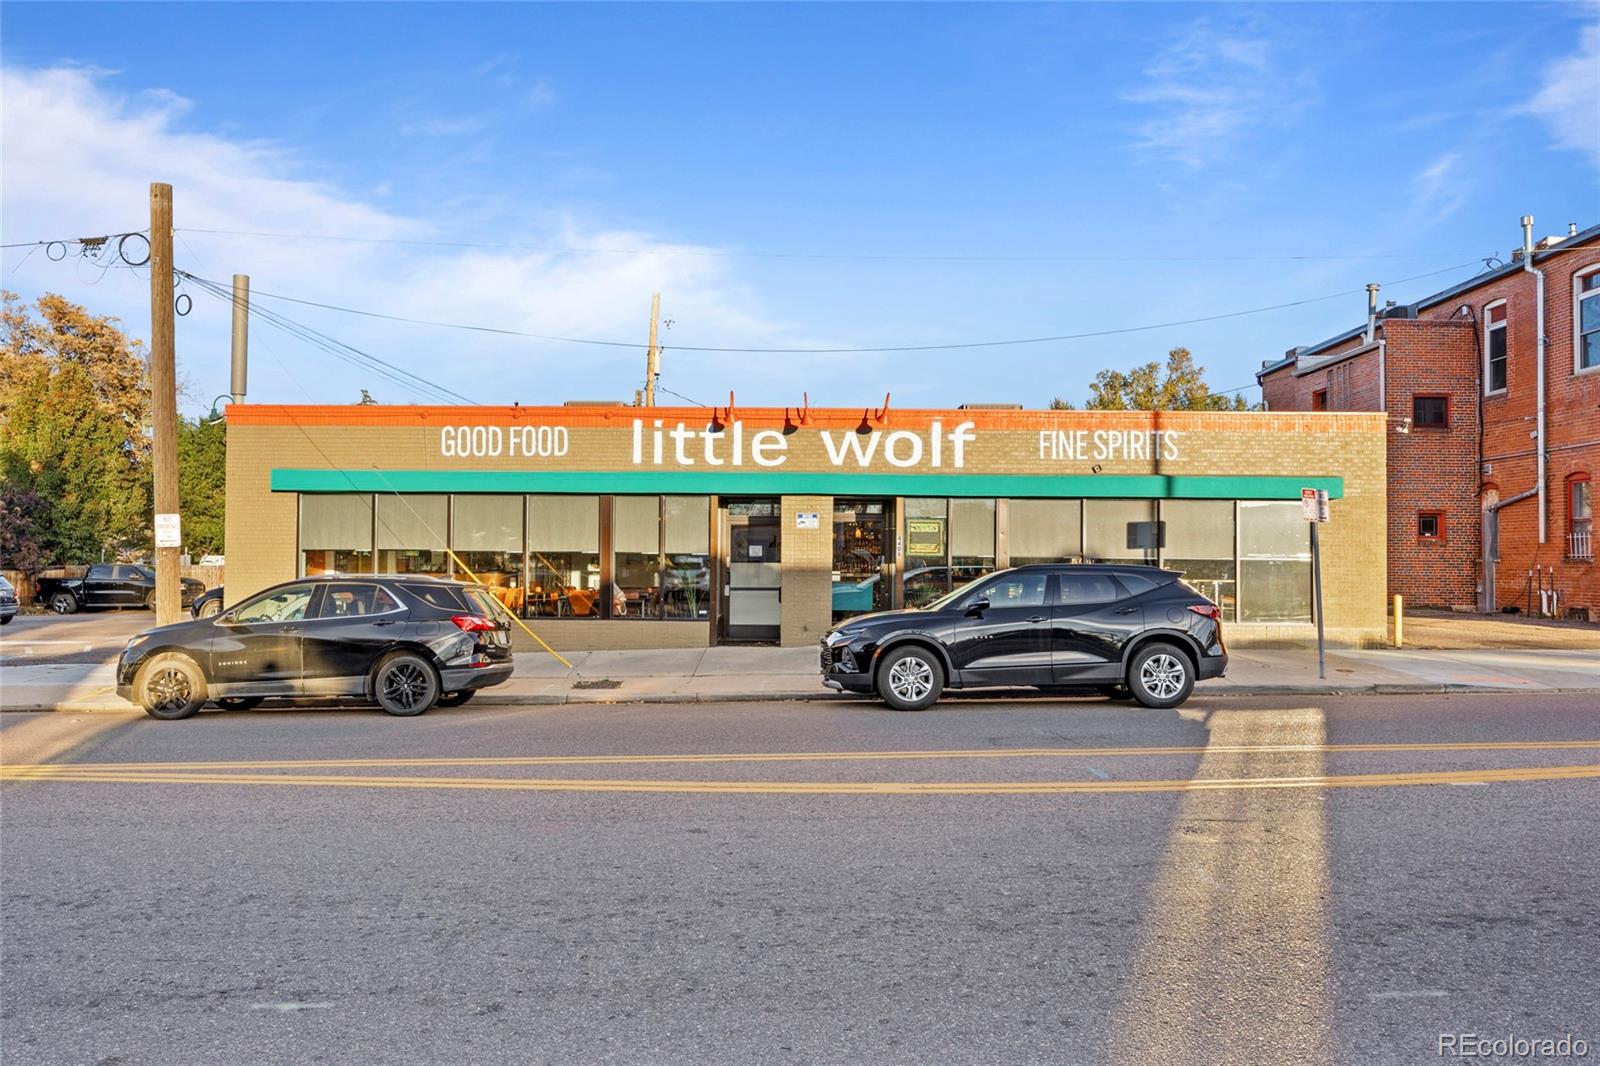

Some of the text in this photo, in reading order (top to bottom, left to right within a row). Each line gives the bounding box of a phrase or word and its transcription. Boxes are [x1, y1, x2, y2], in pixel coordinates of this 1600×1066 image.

[441, 426, 568, 457] GOOD FOOD
[632, 419, 977, 468] little wolf
[1039, 430, 1178, 460] FINE SPIRITS
